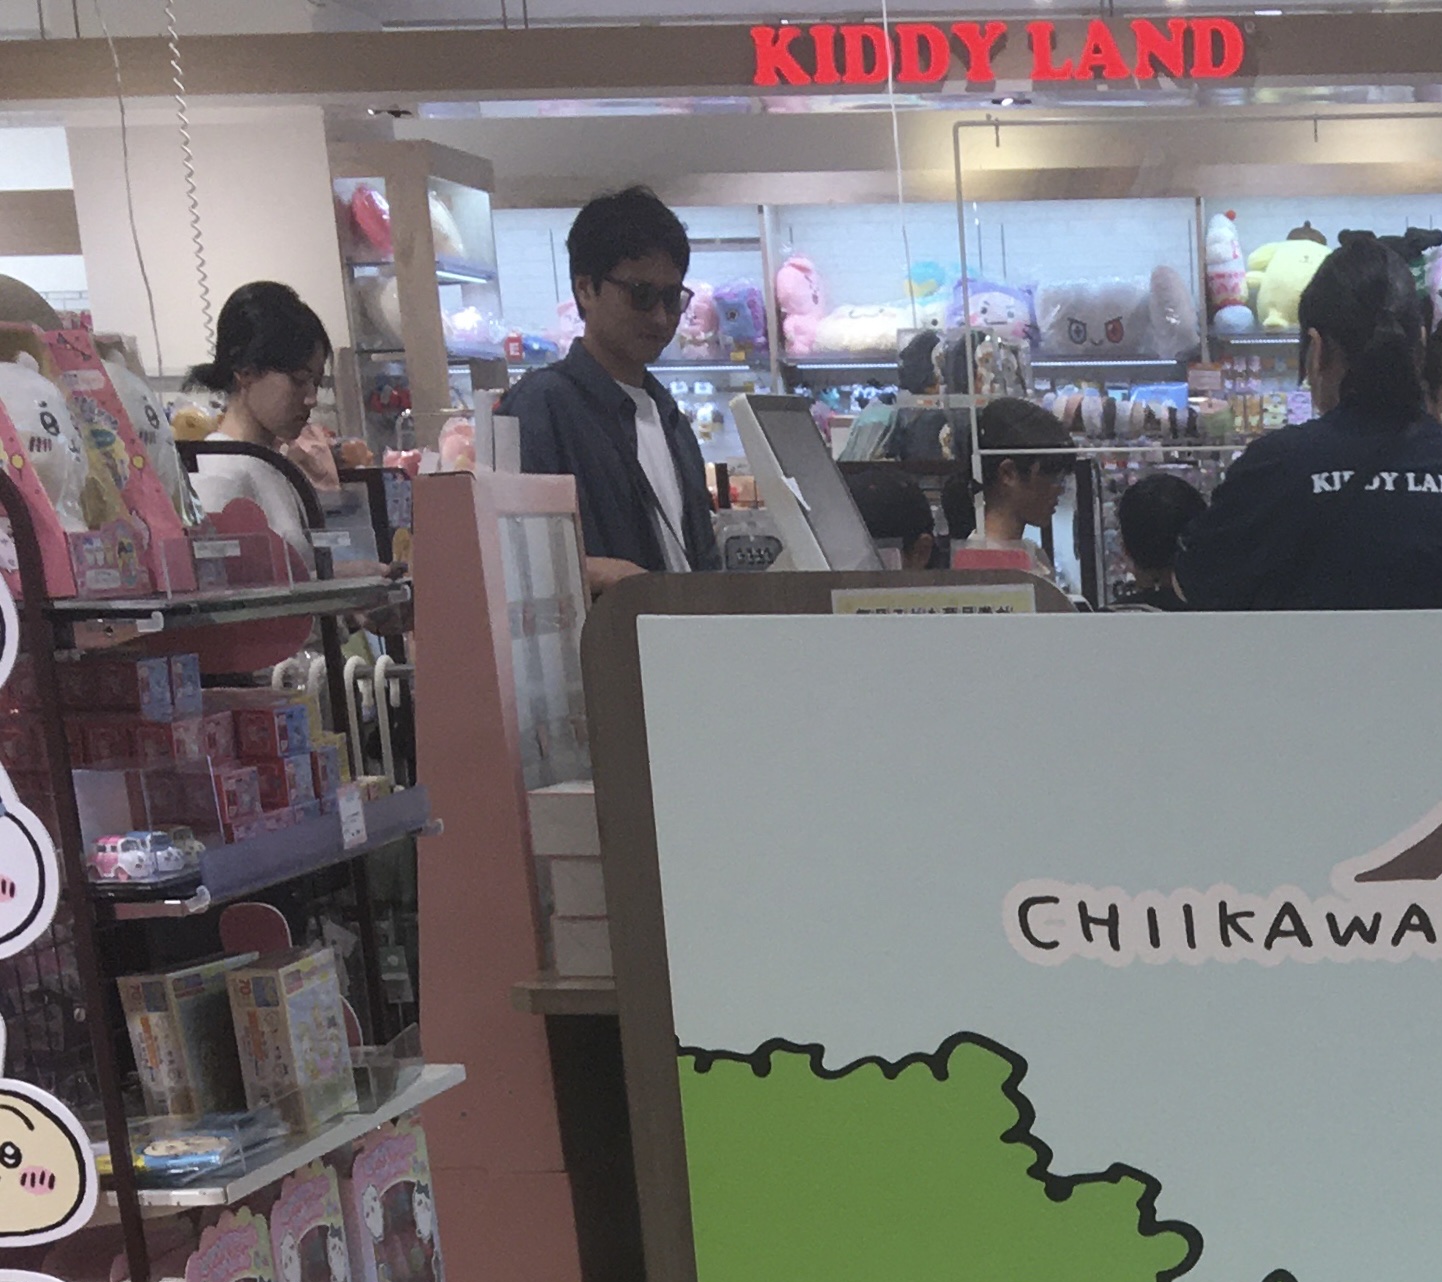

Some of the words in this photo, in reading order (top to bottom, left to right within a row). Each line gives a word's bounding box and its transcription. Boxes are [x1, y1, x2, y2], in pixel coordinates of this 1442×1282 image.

[750, 22, 1007, 87] KIDDY
[1026, 19, 1245, 81] LAND
[1311, 470, 1399, 494] KIY
[1018, 894, 1436, 951] CHIIKAWA
